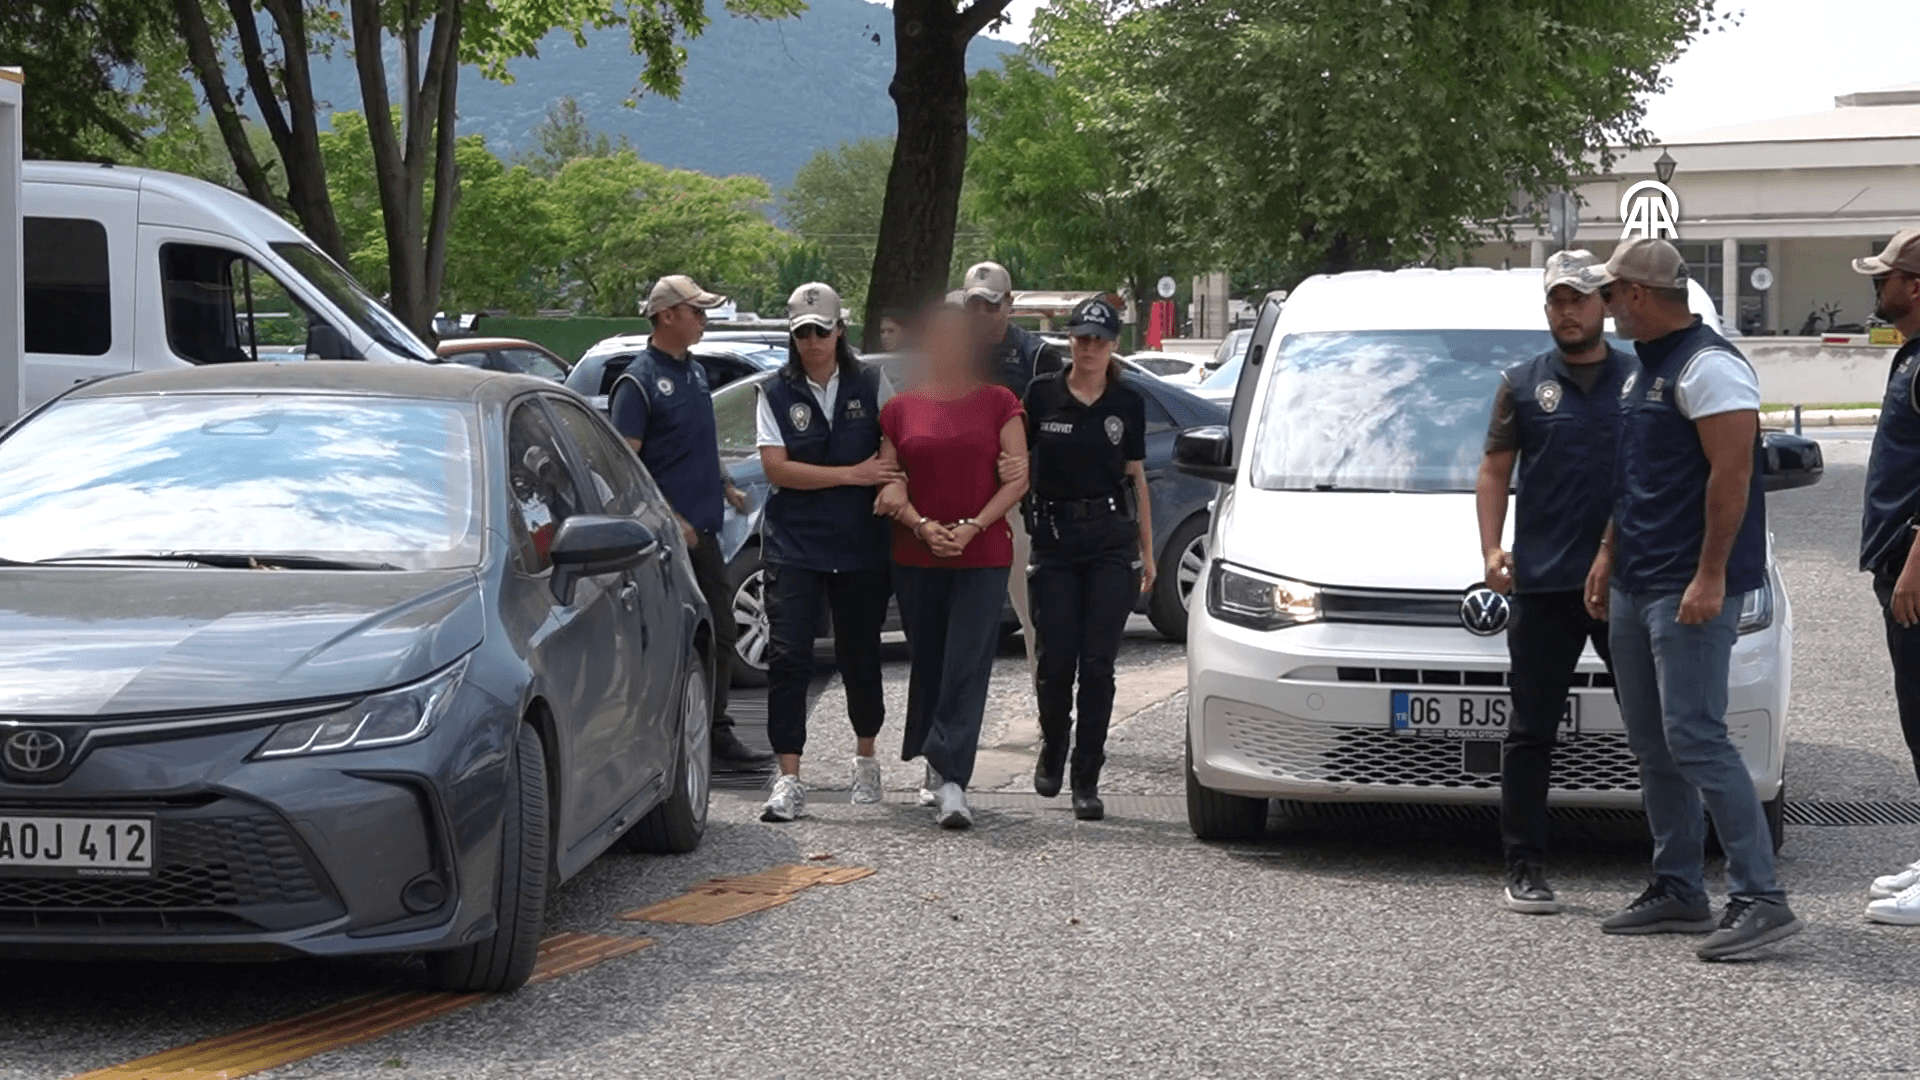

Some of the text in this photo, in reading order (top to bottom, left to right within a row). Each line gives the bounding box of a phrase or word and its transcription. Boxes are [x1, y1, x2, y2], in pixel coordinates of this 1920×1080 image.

[1396, 712, 1407, 721] TR
[1410, 697, 1507, 726] 06 BJS
[0, 822, 145, 861] AOJ 412
